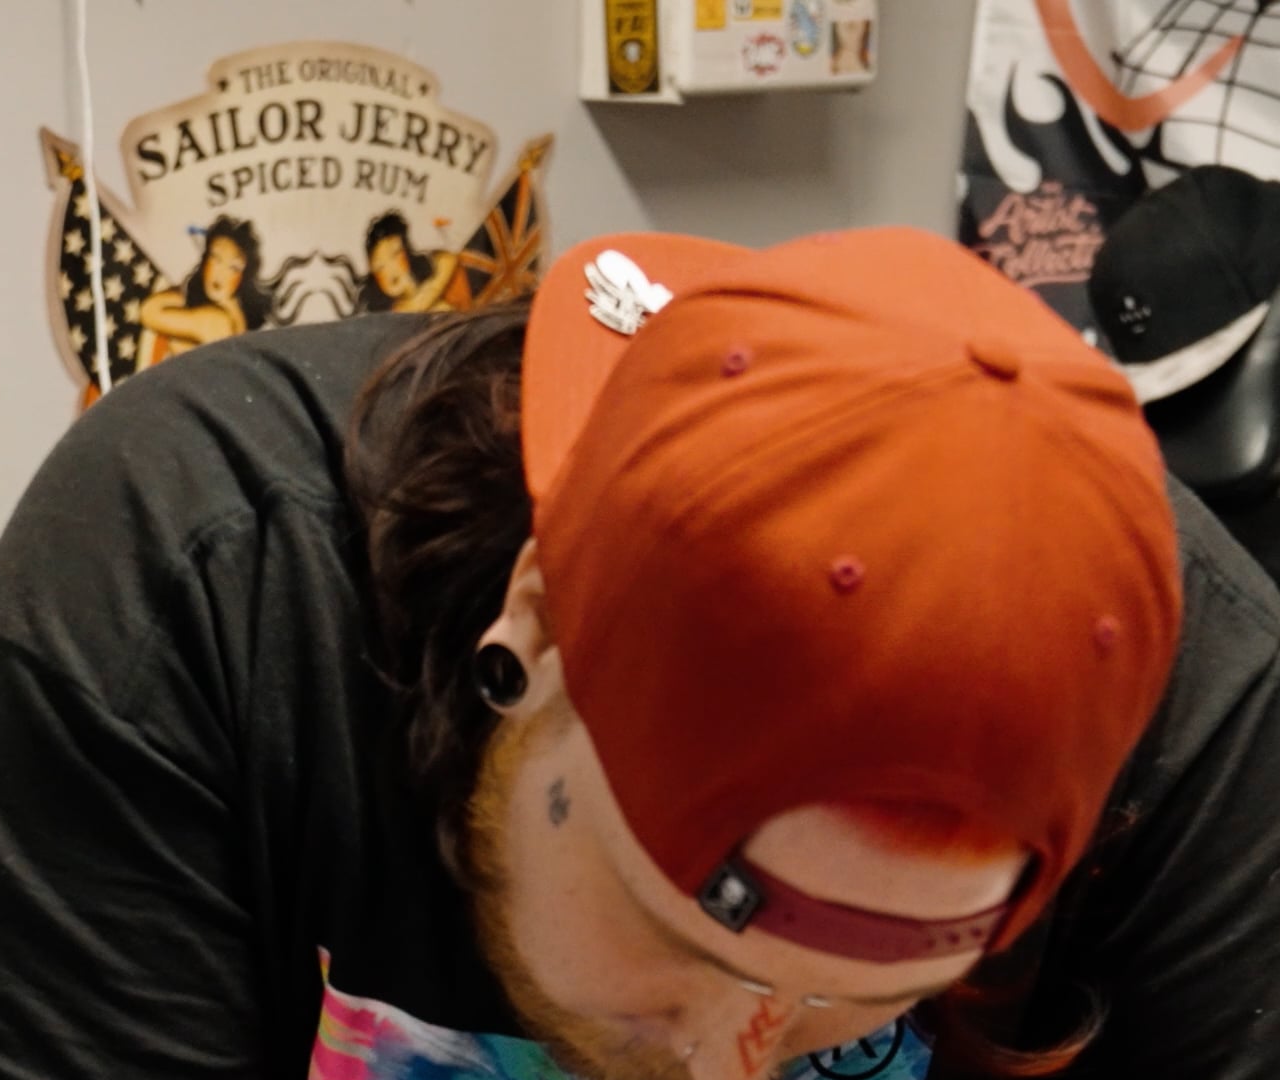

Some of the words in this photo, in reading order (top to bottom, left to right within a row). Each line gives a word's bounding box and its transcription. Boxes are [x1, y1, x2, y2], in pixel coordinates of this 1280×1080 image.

[239, 61, 292, 95] THE
[299, 58, 415, 99] ORIGINAL
[135, 99, 324, 183] SAILOR
[338, 101, 492, 176] JERRY
[206, 157, 345, 207] SPICED
[354, 158, 429, 203] RUM
